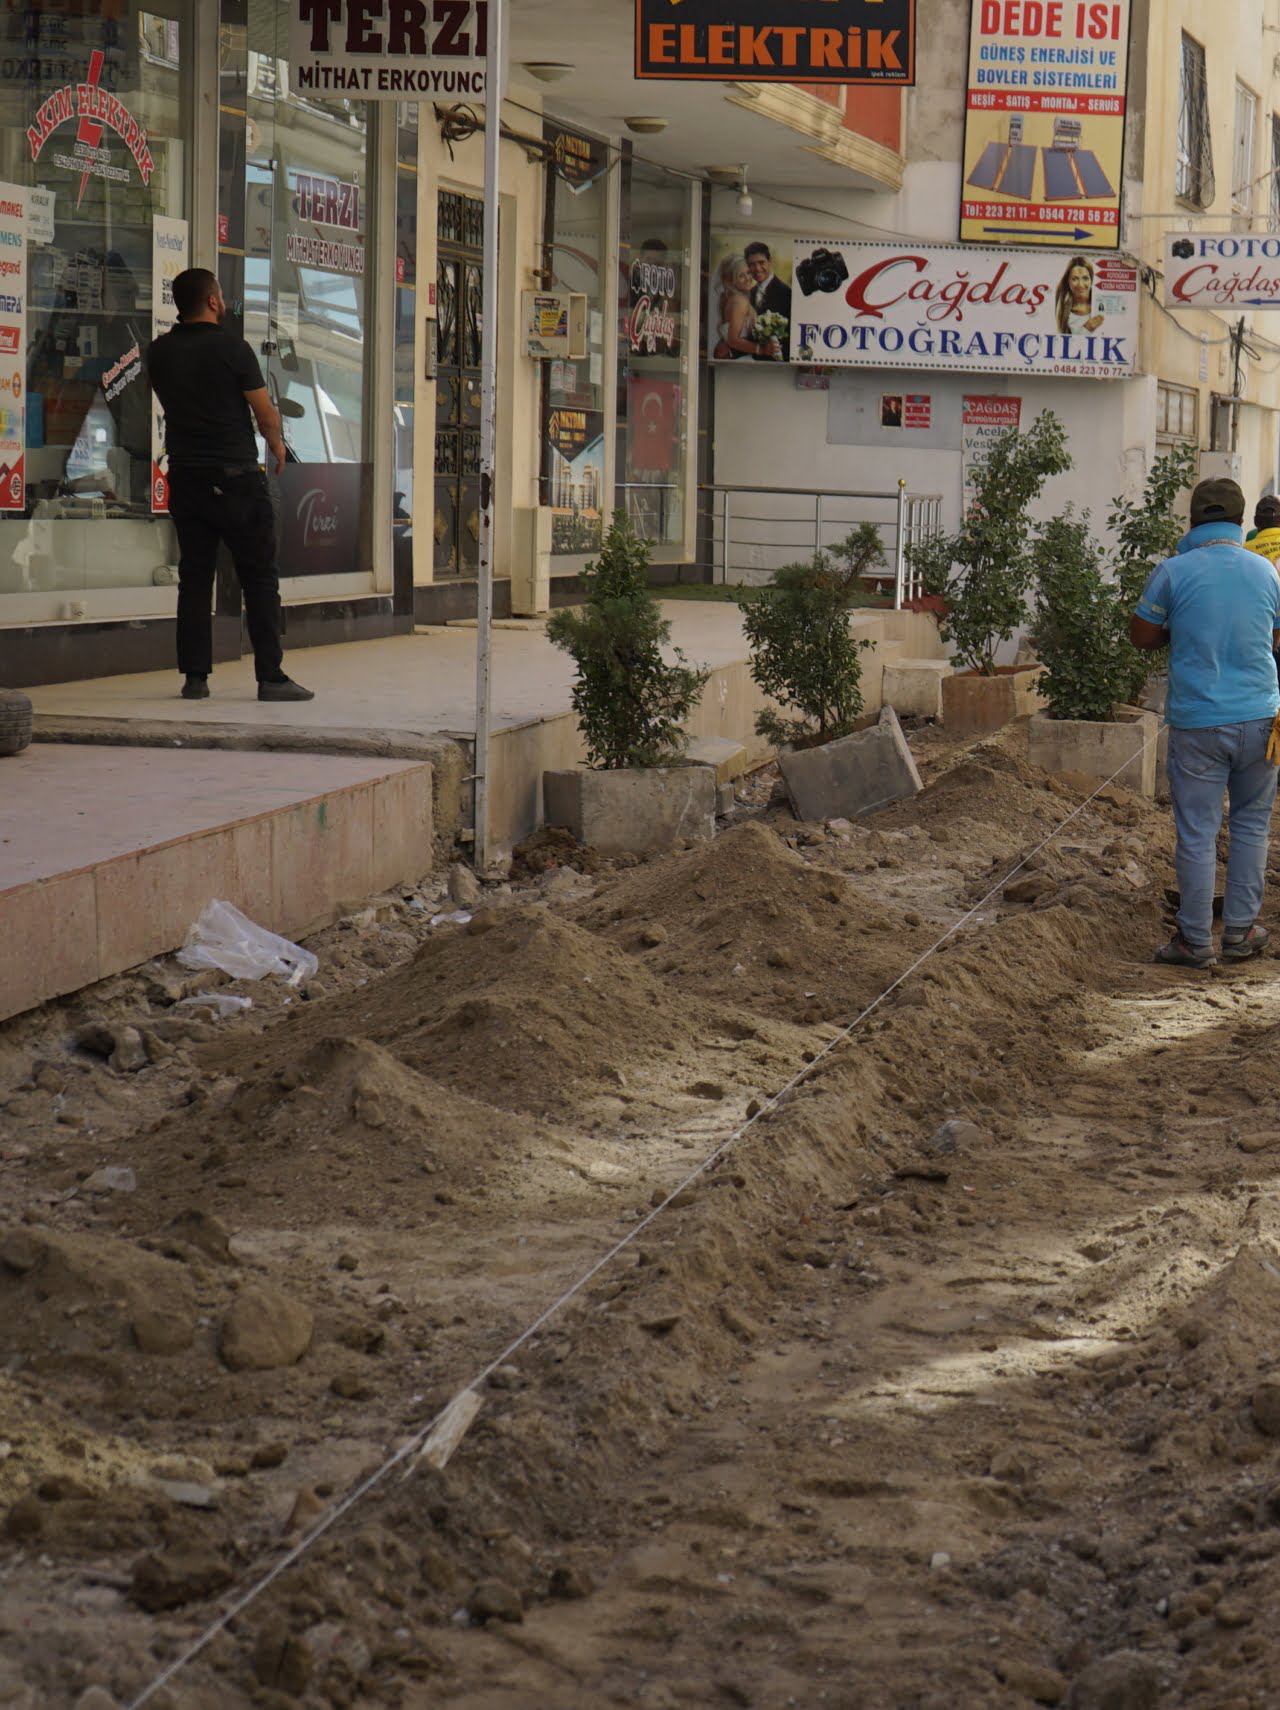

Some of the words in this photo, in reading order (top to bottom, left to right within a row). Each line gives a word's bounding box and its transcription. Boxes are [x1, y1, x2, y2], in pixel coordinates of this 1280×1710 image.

[981, 0, 1063, 37] DEDE
[1076, 3, 1121, 40] ISI
[980, 43, 1025, 64] GÜNEŞ
[1030, 47, 1094, 65] ENERJİSİ
[1100, 51, 1116, 66] VE
[299, 60, 372, 90] MİTHAT
[378, 68, 487, 93] ERKOYUNC
[977, 69, 1028, 86] BOYLER
[1033, 69, 1117, 89] SİSTEMLERİ
[971, 92, 996, 108] KEŞİF
[1006, 94, 1031, 110] SATIŞ
[1041, 96, 1077, 110] MONTAJ
[1088, 98, 1120, 112] SERVİS
[27, 85, 75, 162] AKIM
[77, 83, 154, 187] ELEKTRİK
[296, 170, 360, 232] TERZİ
[965, 204, 983, 217] Tel:
[985, 204, 1003, 217] 223
[1006, 206, 1016, 218] 21
[1019, 207, 1028, 218] 11
[1039, 208, 1065, 221] 0544
[1103, 211, 1116, 223] 22
[641, 261, 675, 299] FOTO
[845, 255, 1049, 322] Çağdaş
[798, 321, 1128, 365] FOTOĞRAFÇILIK
[1054, 364, 1077, 374] 0484
[1080, 365, 1096, 375] 223
[1098, 366, 1110, 376] 70
[1112, 367, 1123, 377] 77
[968, 401, 1018, 417] ÇAĞDAŞ
